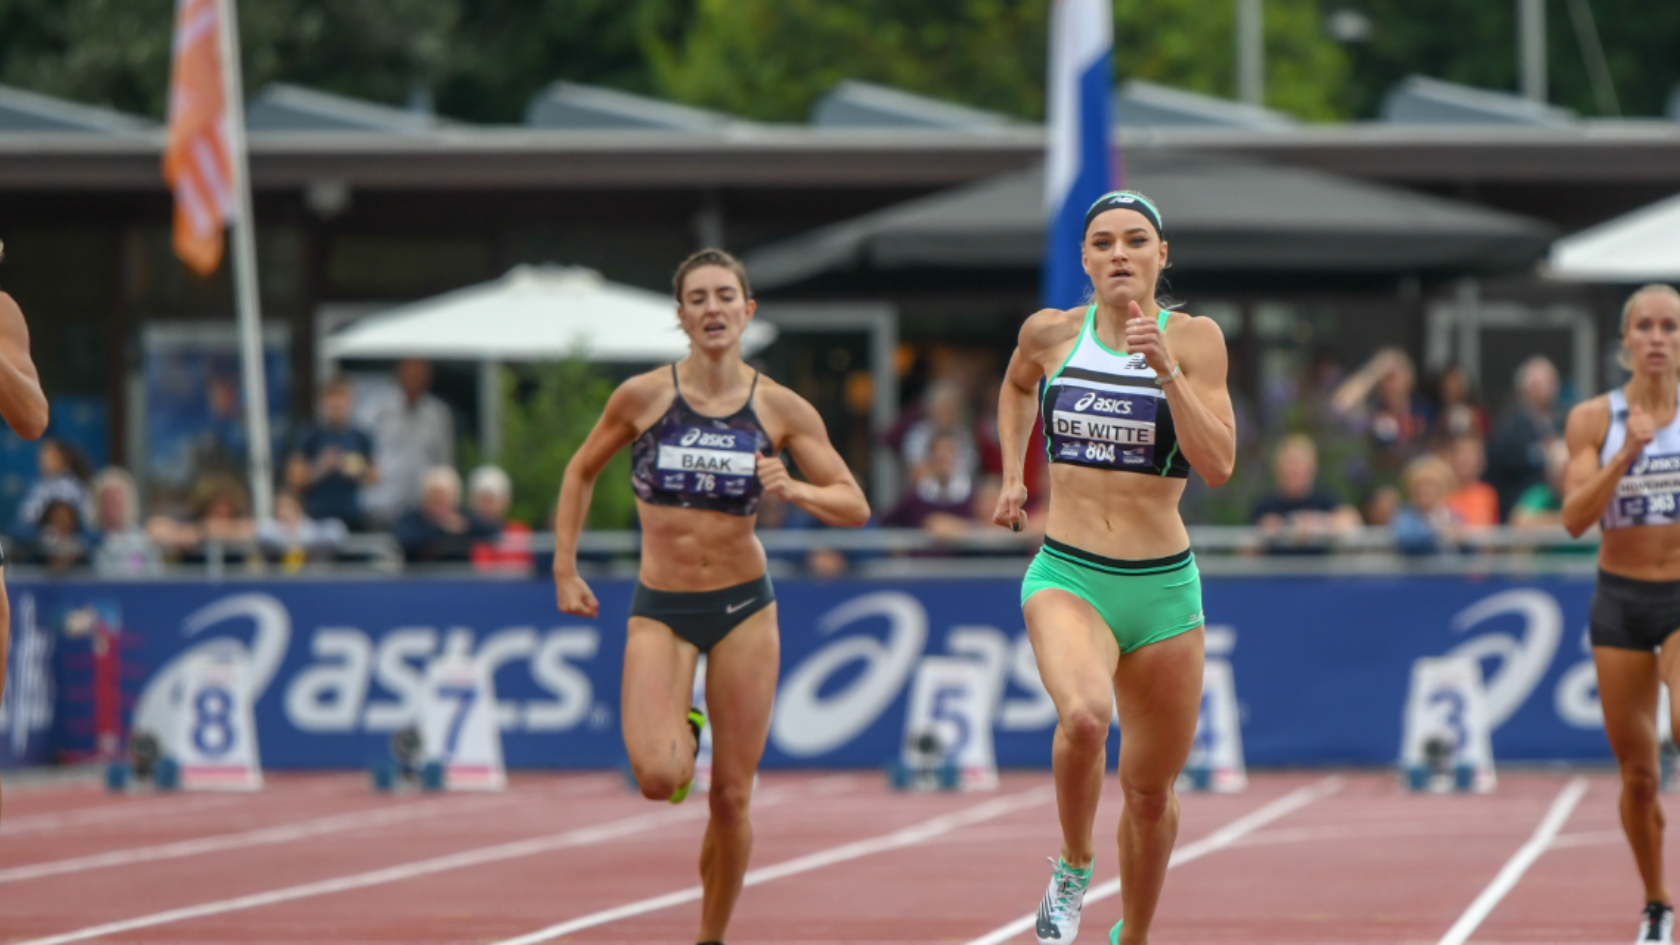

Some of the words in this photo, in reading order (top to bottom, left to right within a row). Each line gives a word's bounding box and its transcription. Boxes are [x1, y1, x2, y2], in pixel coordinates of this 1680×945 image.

[1093, 397, 1133, 414] asics
[698, 432, 736, 448] asics
[1057, 418, 1082, 436] DE
[1087, 421, 1149, 443] WITTE
[1085, 441, 1116, 463] 804
[681, 454, 732, 472] BAAK
[695, 473, 716, 492] 76
[190, 685, 236, 757] 8
[437, 685, 478, 764] 7
